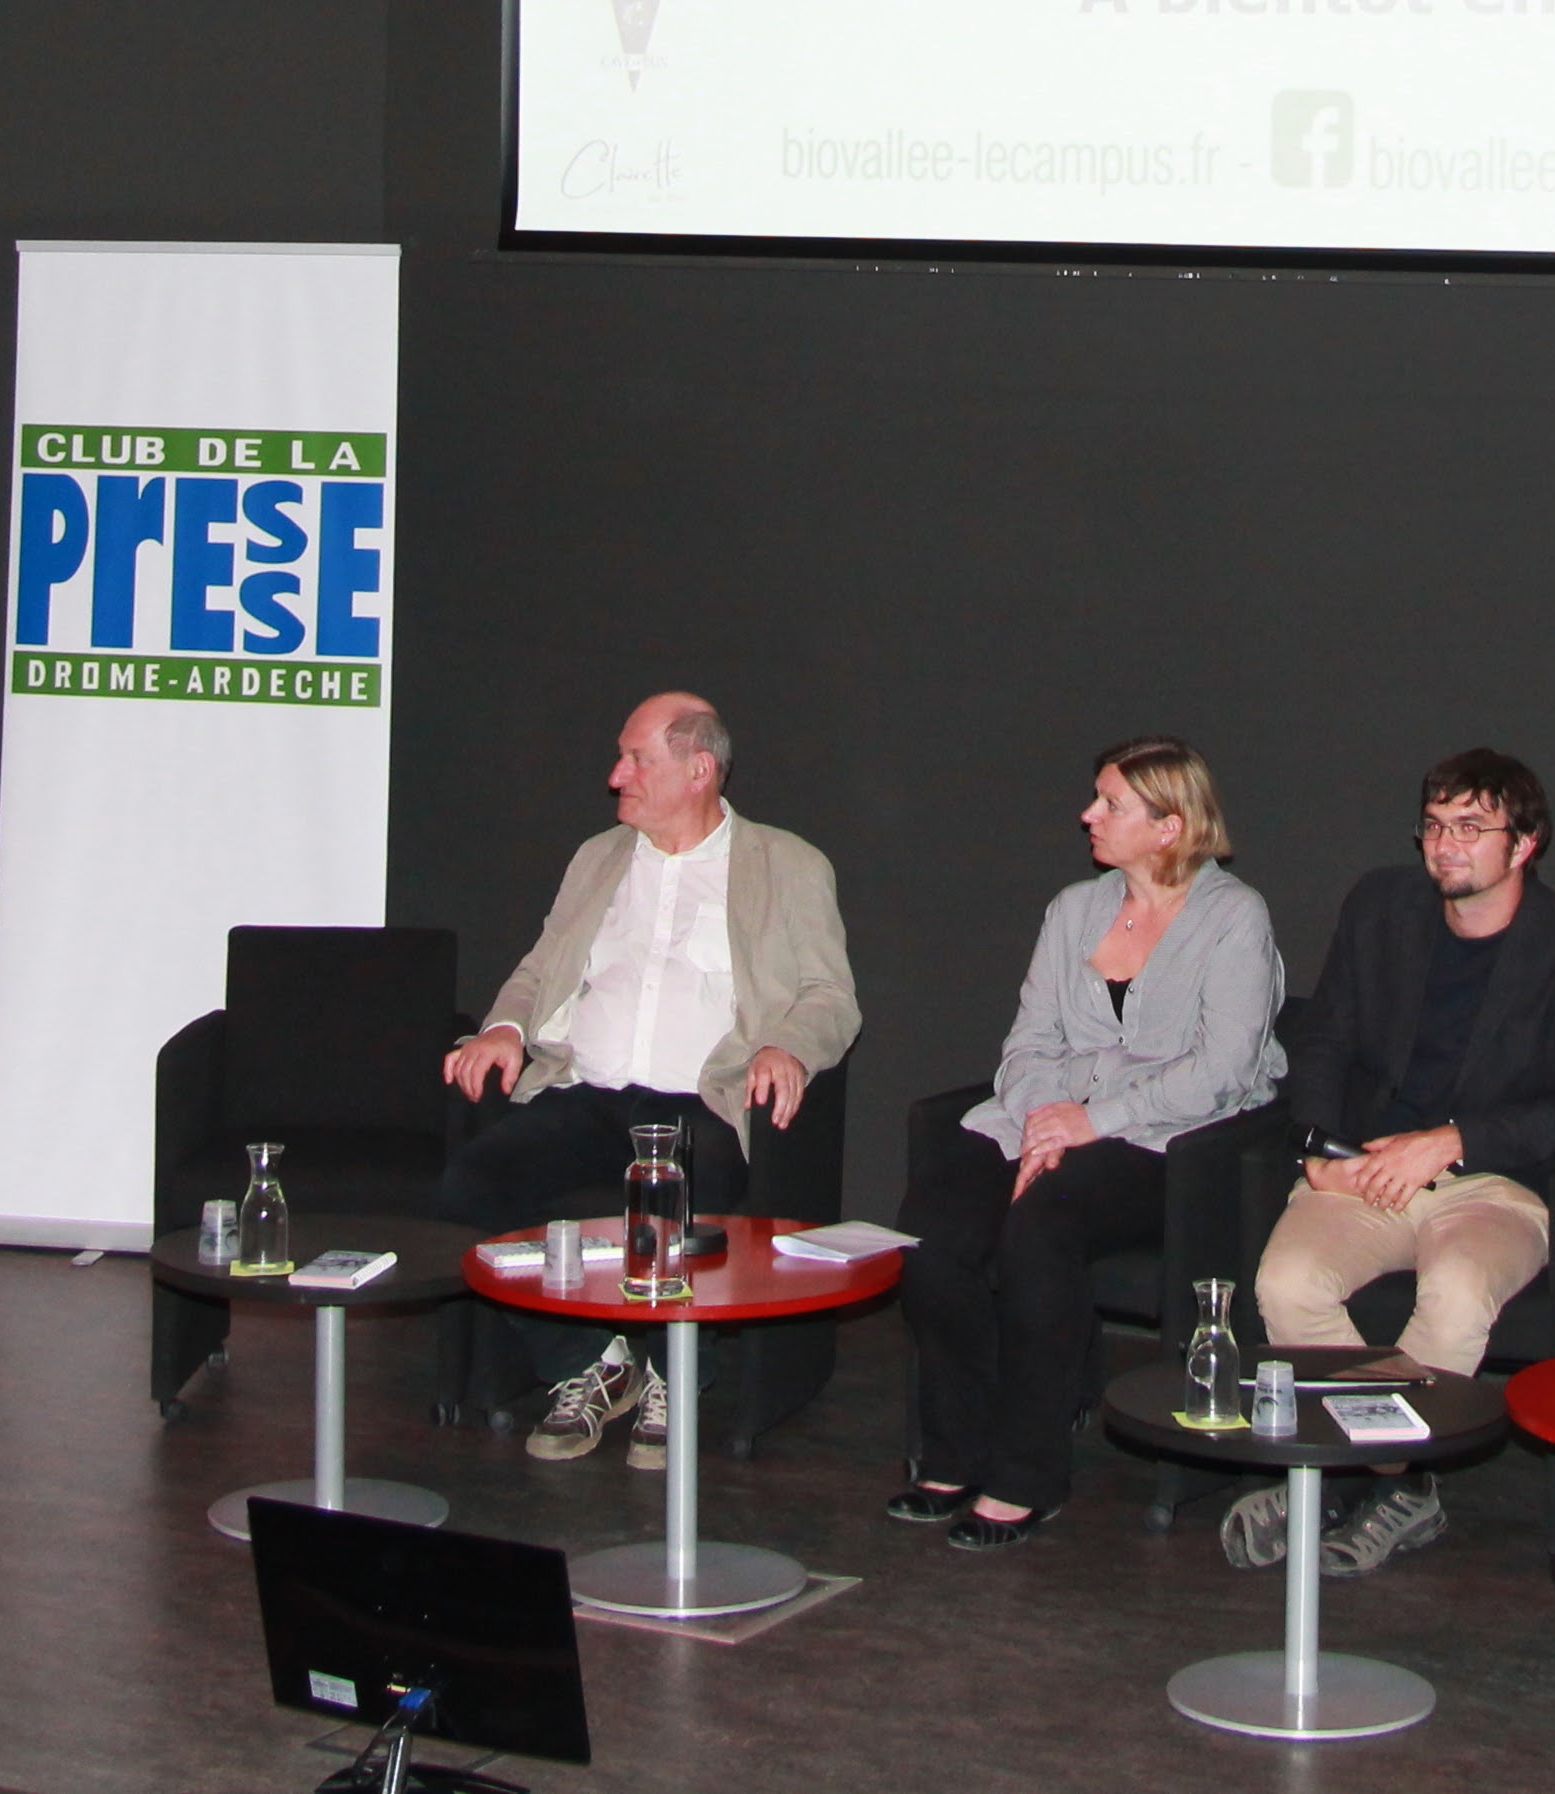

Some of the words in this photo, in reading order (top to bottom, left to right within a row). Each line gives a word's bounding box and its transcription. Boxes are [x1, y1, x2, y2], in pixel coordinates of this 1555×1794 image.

[783, 128, 1220, 194] biovallee-lecampus.fr
[37, 433, 165, 465] CLUB
[198, 437, 262, 467] DE
[291, 440, 361, 470] LA
[28, 660, 368, 699] DROME-ARDECHE
